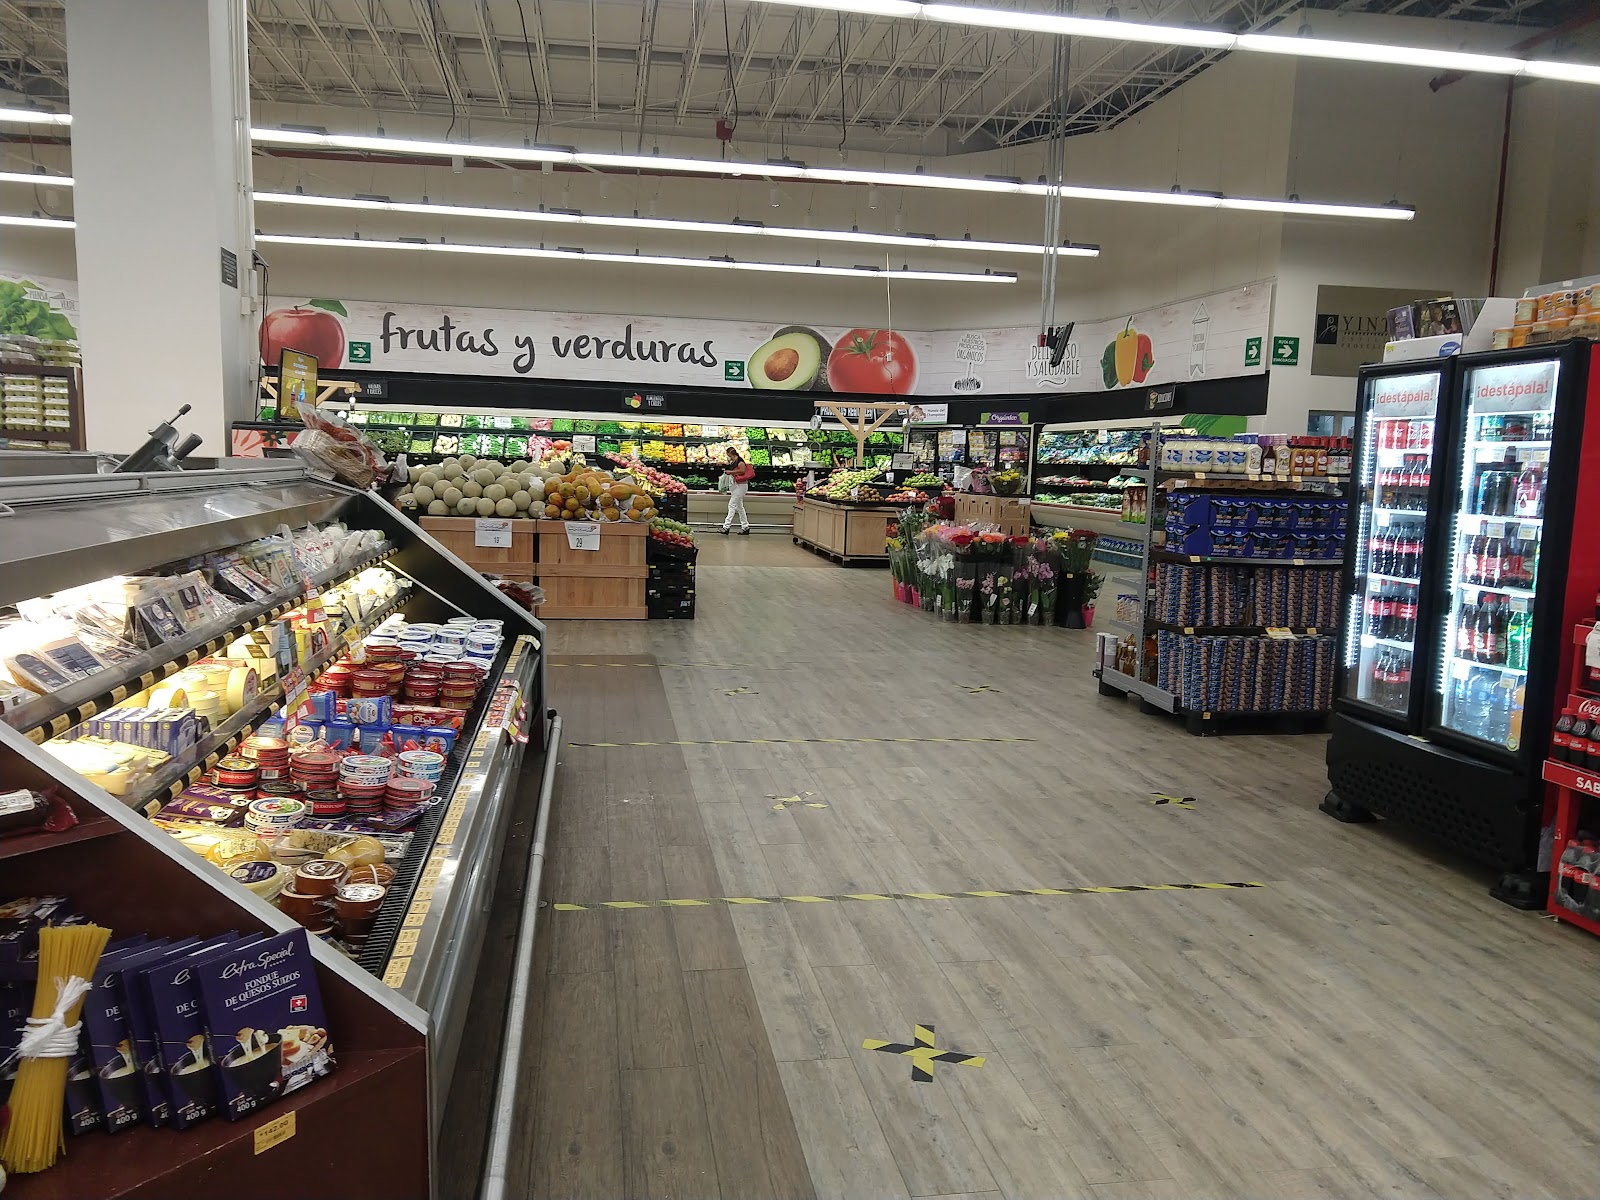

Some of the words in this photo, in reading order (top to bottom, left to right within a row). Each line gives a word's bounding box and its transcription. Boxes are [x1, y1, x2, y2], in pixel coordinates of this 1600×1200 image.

[380, 311, 499, 357] frutas
[512, 334, 536, 375] y
[551, 323, 718, 368] verduras
[1376, 389, 1434, 405] ¡destápala!
[1476, 380, 1549, 399] ¡destápala!
[413, 714, 436, 726] Obela
[245, 970, 279, 990] FONDUE
[225, 998, 238, 1008] DE
[238, 982, 271, 1002] QUESOS
[272, 970, 301, 987] SUIZOS
[185, 1110, 200, 1120] 400
[237, 1102, 250, 1112] 400
